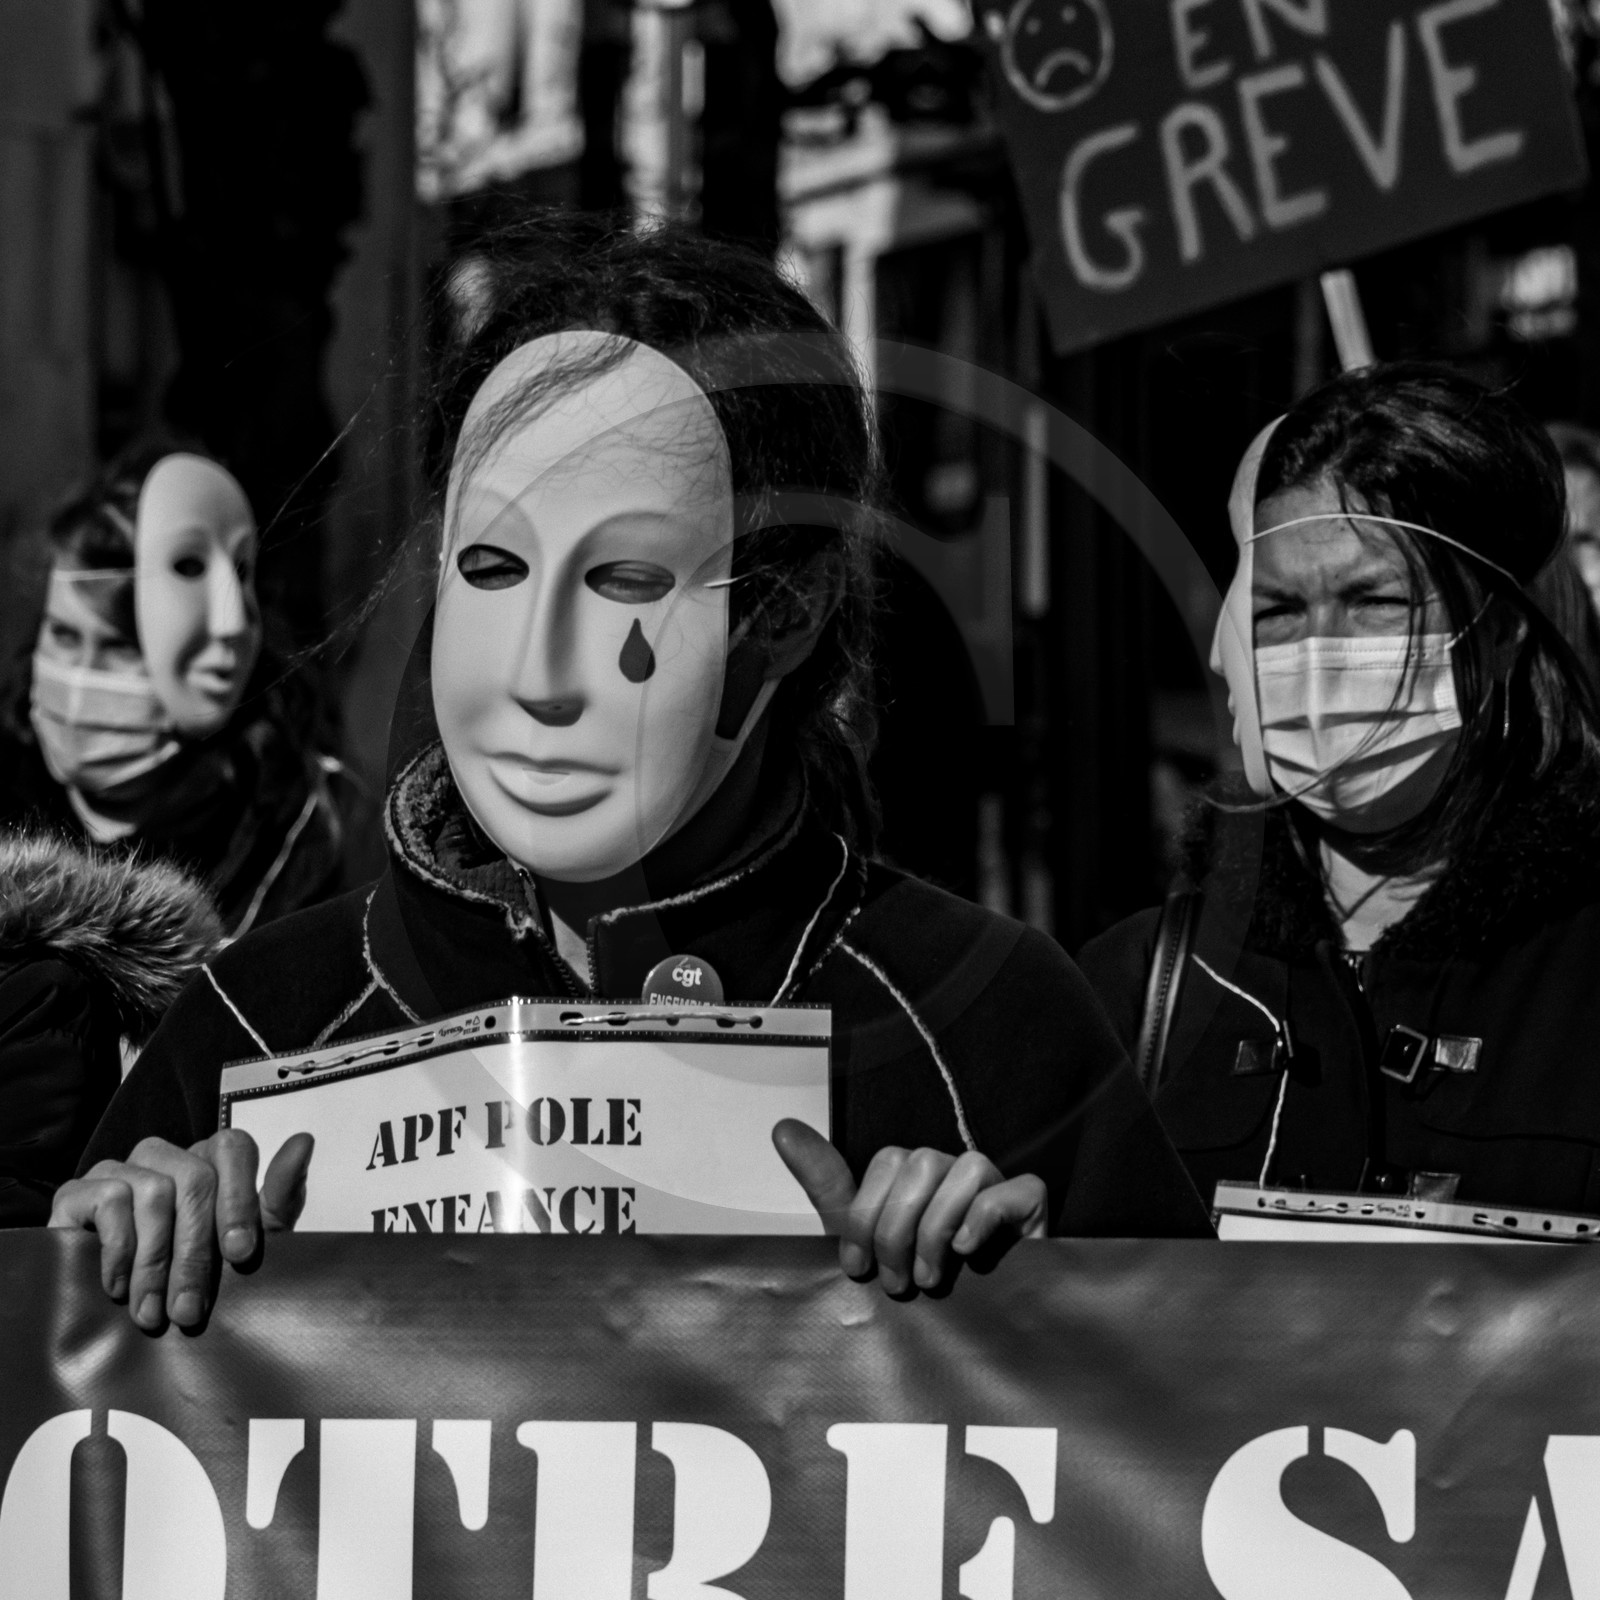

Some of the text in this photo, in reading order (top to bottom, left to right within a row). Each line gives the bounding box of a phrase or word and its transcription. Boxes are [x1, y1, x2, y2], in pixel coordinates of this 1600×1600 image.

[1171, 0, 1326, 88] EN
[1060, 0, 1525, 290] GREVE
[672, 967, 702, 987] cgt
[366, 1097, 642, 1170] APF POLE
